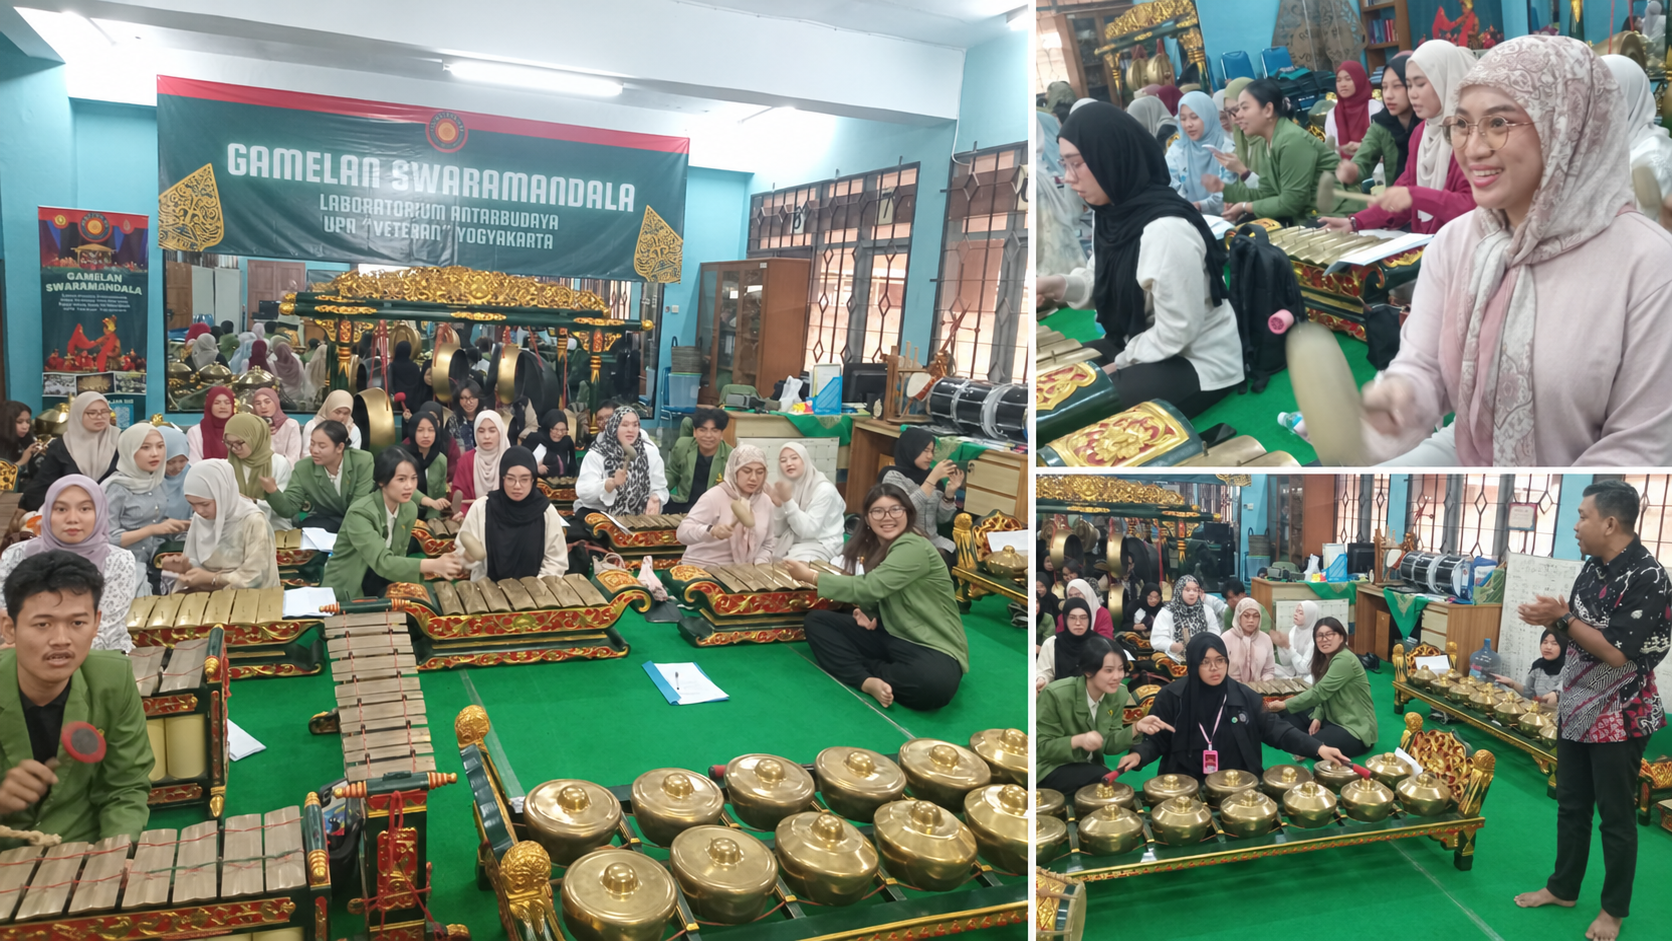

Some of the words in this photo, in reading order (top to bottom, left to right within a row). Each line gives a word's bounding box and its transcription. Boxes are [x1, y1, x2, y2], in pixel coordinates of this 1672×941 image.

[227, 143, 380, 188] GAMELAN
[391, 159, 636, 213] SWARAMANDALA
[319, 193, 446, 221] LABORATORIUM
[450, 205, 559, 230] ANTARBUDAYA
[457, 226, 554, 249] YOGYAKARTA
[45, 282, 142, 295] SWARAMANDALA
[66, 272, 122, 282] GAMELAN
